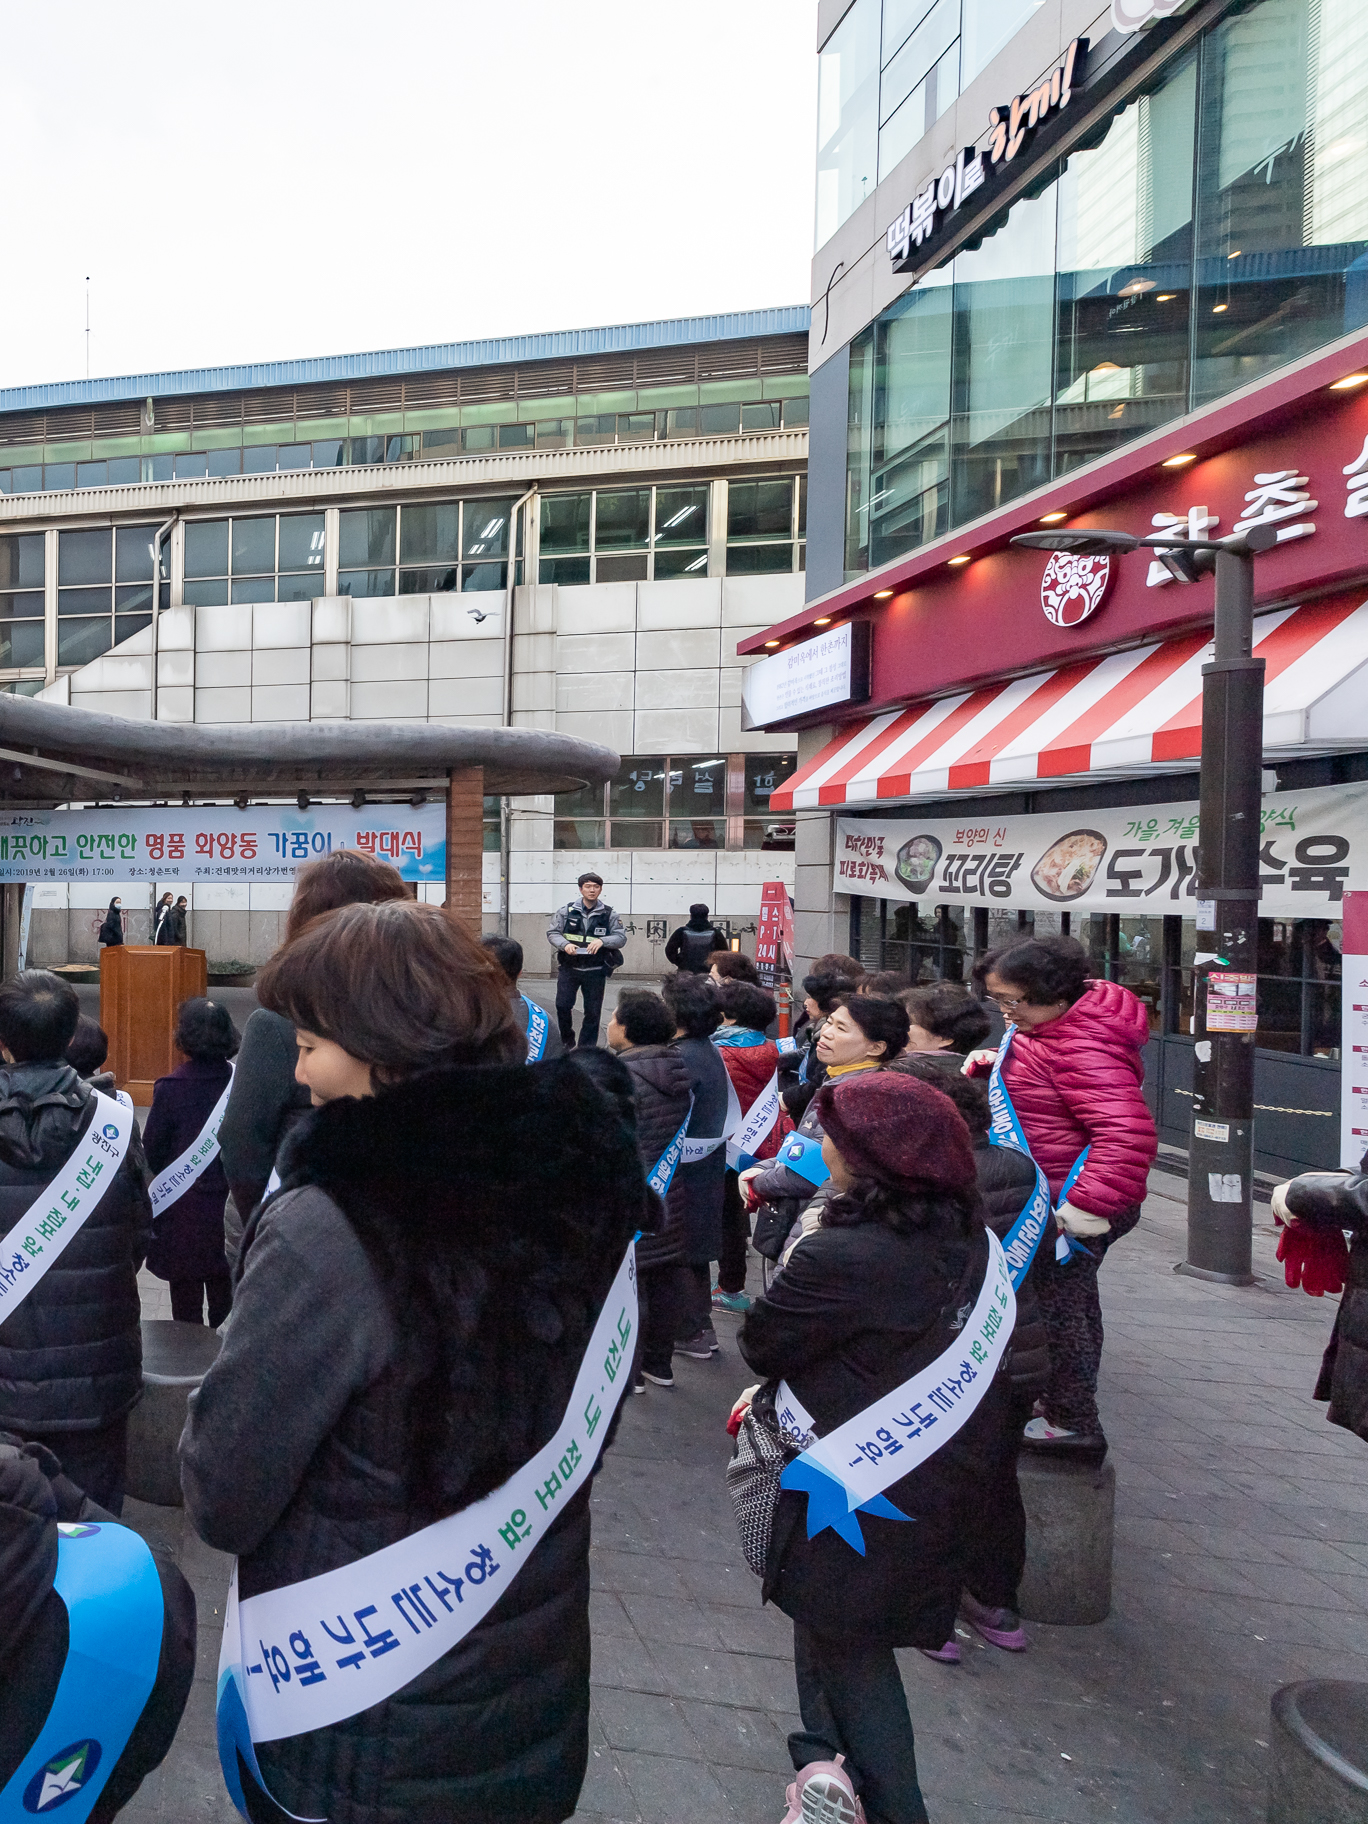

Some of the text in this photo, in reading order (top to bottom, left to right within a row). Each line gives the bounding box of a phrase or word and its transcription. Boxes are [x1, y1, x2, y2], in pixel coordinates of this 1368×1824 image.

[887, 38, 1078, 260] 떡볶이로 한끼!
[1145, 434, 1368, 587] 한촌
[76, 833, 138, 860] 안전한
[145, 833, 186, 860] 명품
[195, 832, 258, 860] 화양동
[953, 827, 1007, 848] 보양의 신
[44, 867, 56, 877] 2월
[92, 867, 114, 876] 17:00
[939, 852, 1025, 898] 꼬리탕
[757, 943, 776, 960] 24시
[750, 1112, 769, 1129] 내가
[91, 1130, 120, 1159] 광진구
[167, 1163, 195, 1187] 청소는
[34, 1206, 68, 1242] 점포
[21, 1235, 45, 1259] 앞
[980, 1304, 1004, 1346] 점포
[969, 1340, 989, 1365] 앞
[927, 1360, 979, 1413] 청소는
[892, 1402, 939, 1440] 내가
[848, 1427, 904, 1468] 해요!
[534, 1437, 583, 1512] 점포
[497, 1508, 533, 1552] 앞
[390, 1543, 501, 1636] 청소는
[320, 1604, 401, 1671] 내가
[246, 1630, 328, 1695] 해요!
